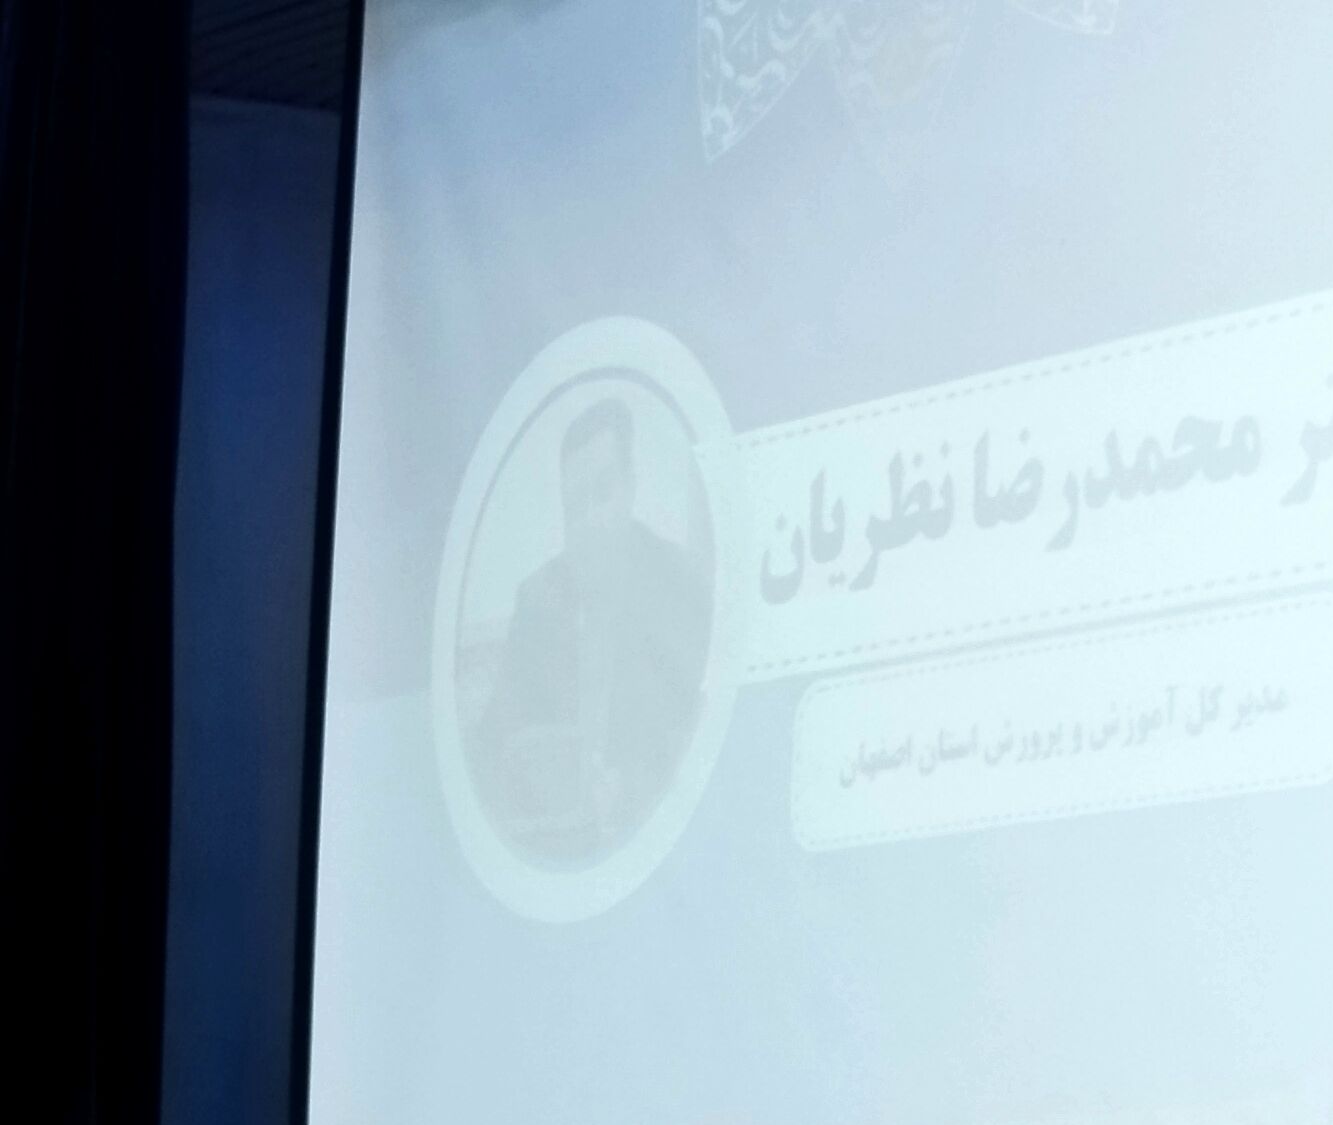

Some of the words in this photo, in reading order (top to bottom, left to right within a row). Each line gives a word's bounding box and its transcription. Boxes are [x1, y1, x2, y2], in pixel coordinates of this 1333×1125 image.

[758, 440, 956, 608] نظریان
[838, 730, 913, 791] اصفهان
[918, 722, 979, 778] استان
